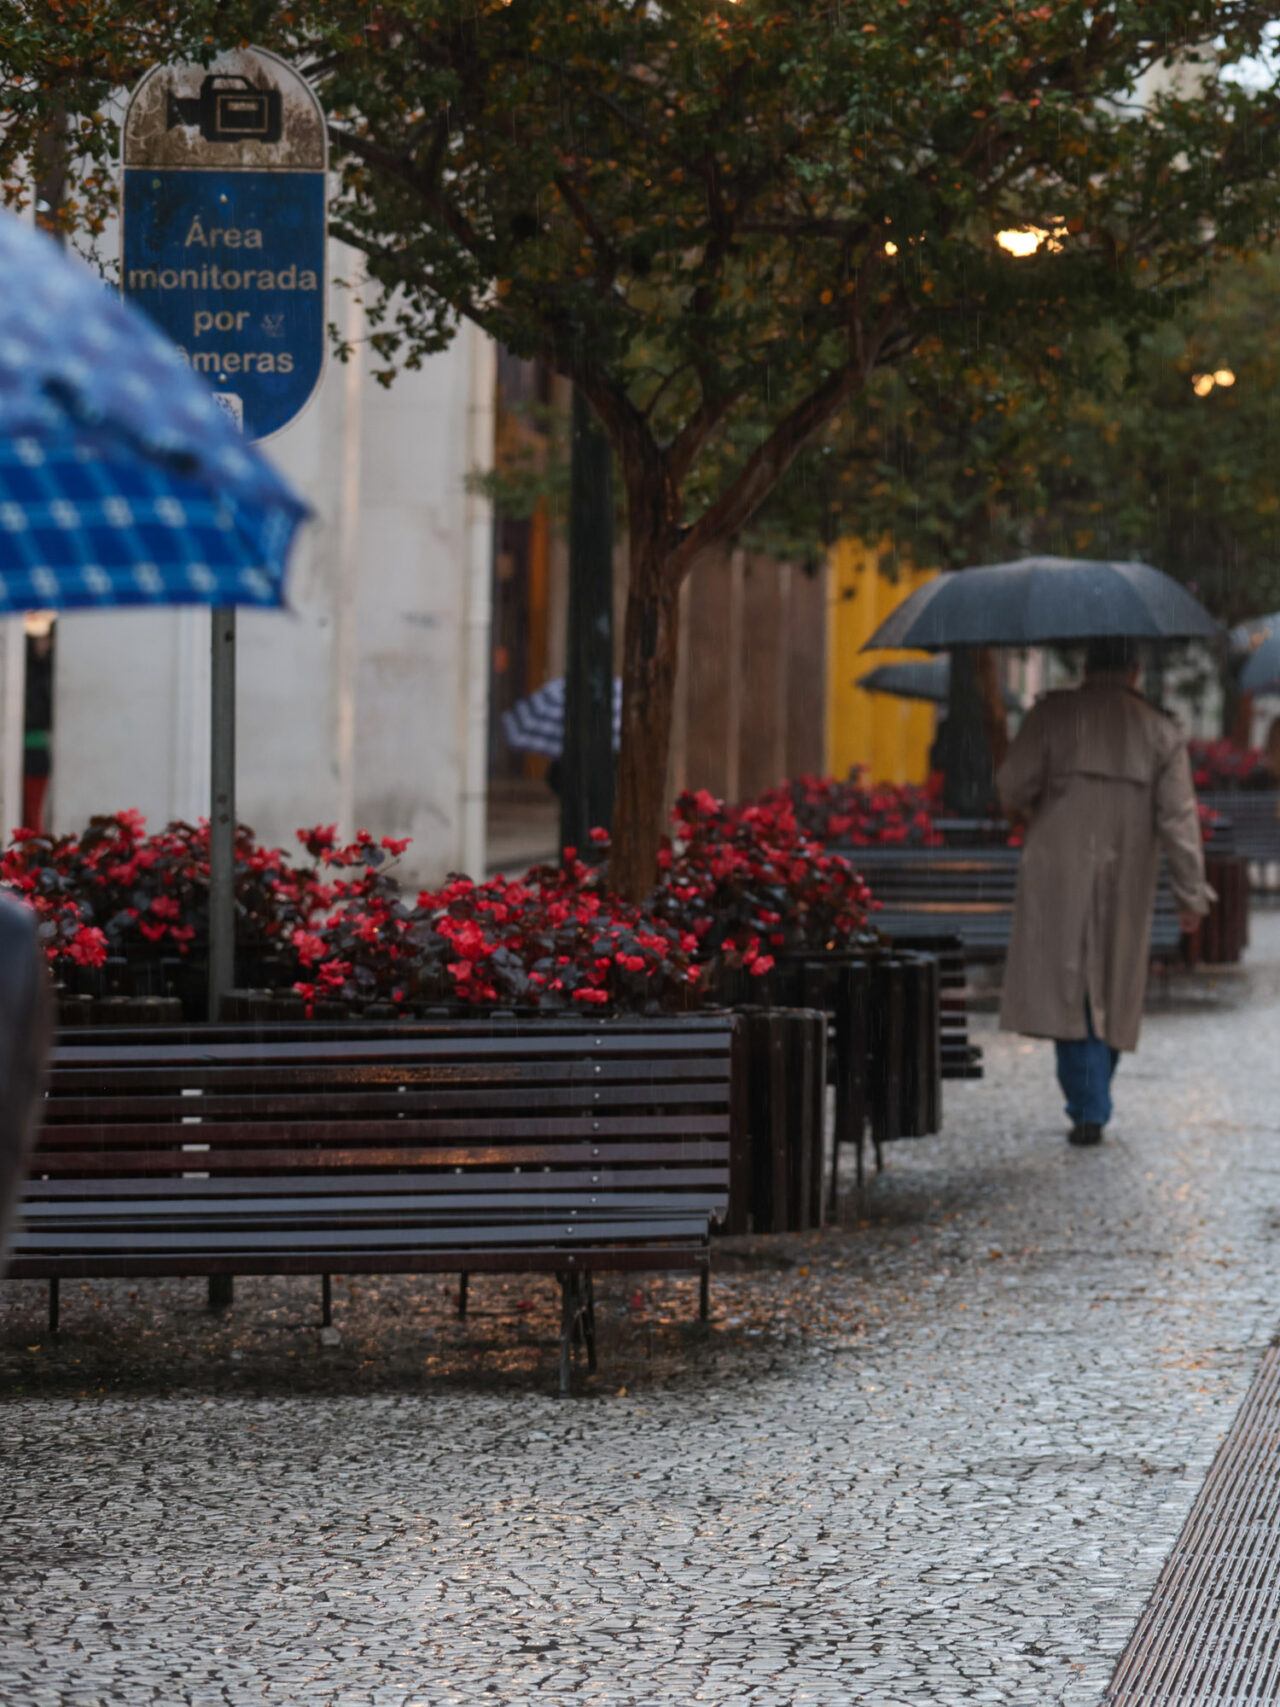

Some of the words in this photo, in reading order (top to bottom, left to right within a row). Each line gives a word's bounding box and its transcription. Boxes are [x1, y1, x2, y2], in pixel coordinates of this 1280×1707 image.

[184, 215, 263, 248] Área
[129, 265, 318, 290] monitorada
[193, 310, 250, 337] por
[175, 344, 295, 374] âmeras
